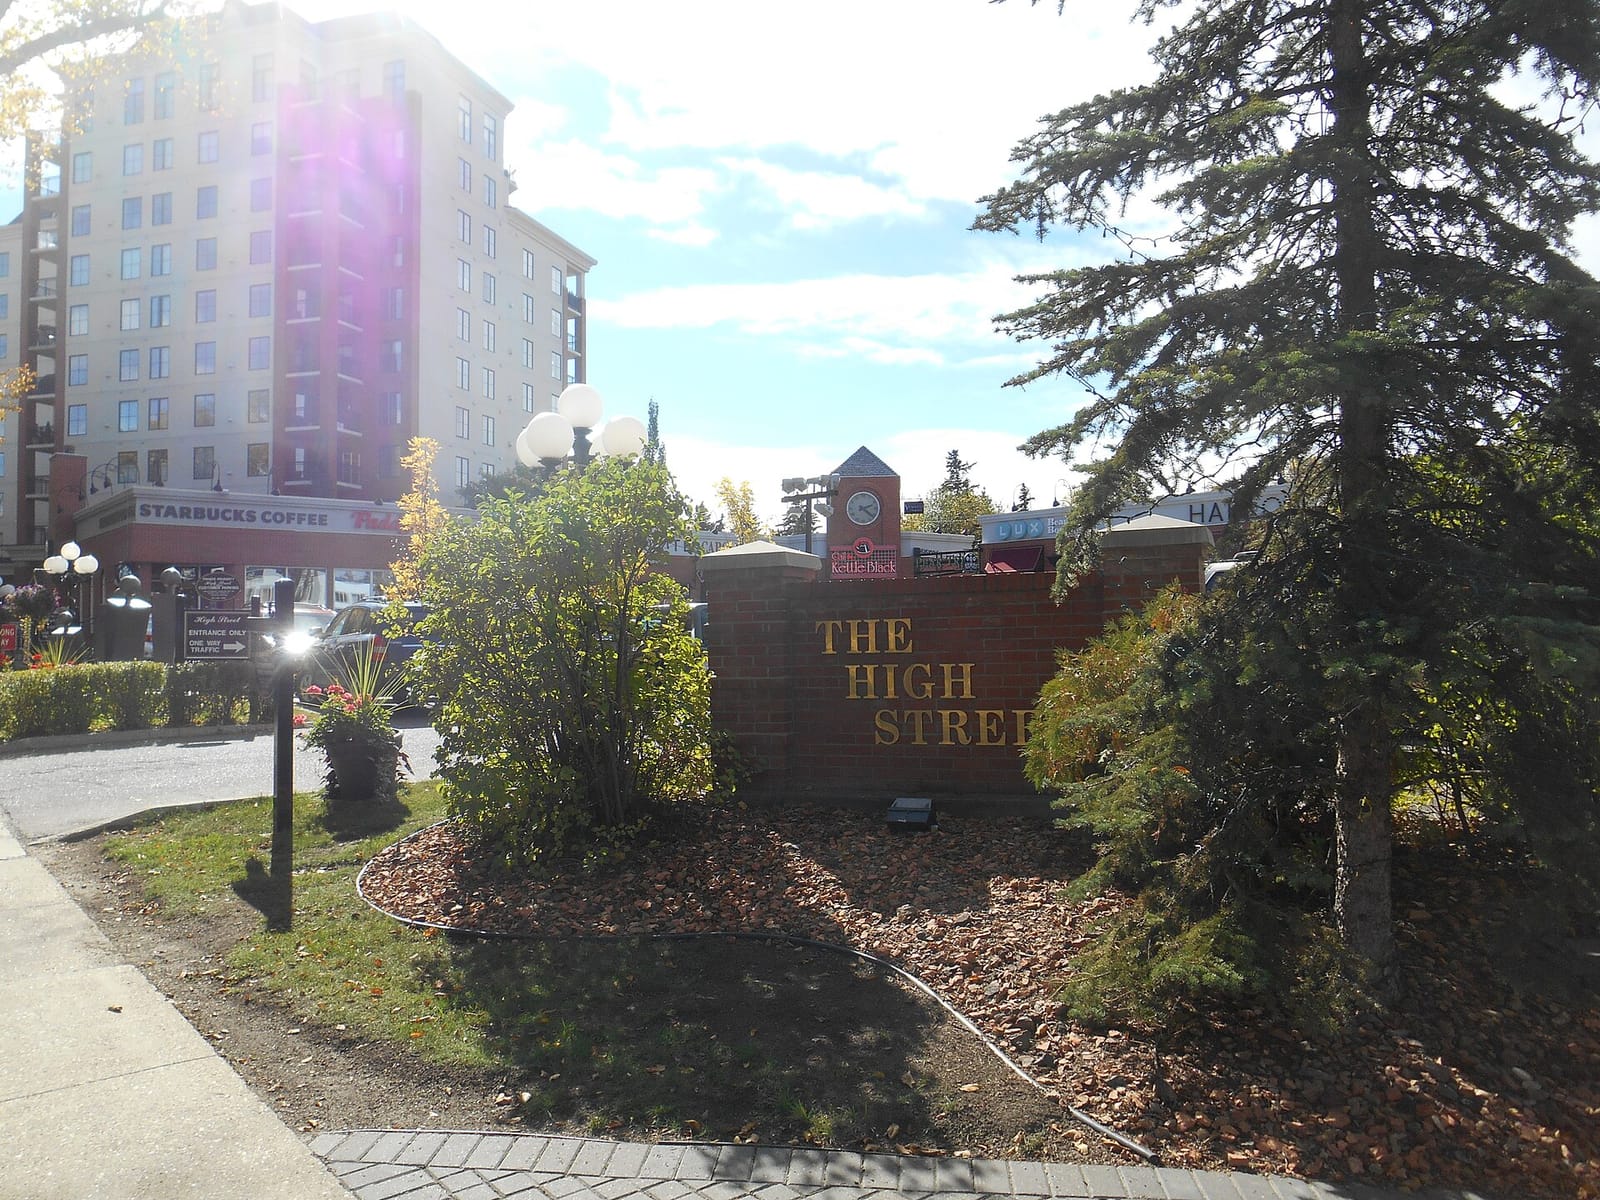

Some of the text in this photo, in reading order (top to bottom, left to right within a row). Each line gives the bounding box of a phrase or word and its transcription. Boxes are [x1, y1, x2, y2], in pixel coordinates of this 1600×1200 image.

[139, 503, 328, 526] STARBUCKS COFFEE
[999, 522, 1039, 535] LUX
[867, 561, 896, 573] Black
[194, 615, 241, 625] High Street
[815, 617, 913, 655] THE
[844, 663, 976, 700] HIGH
[874, 709, 1037, 746] STREE
